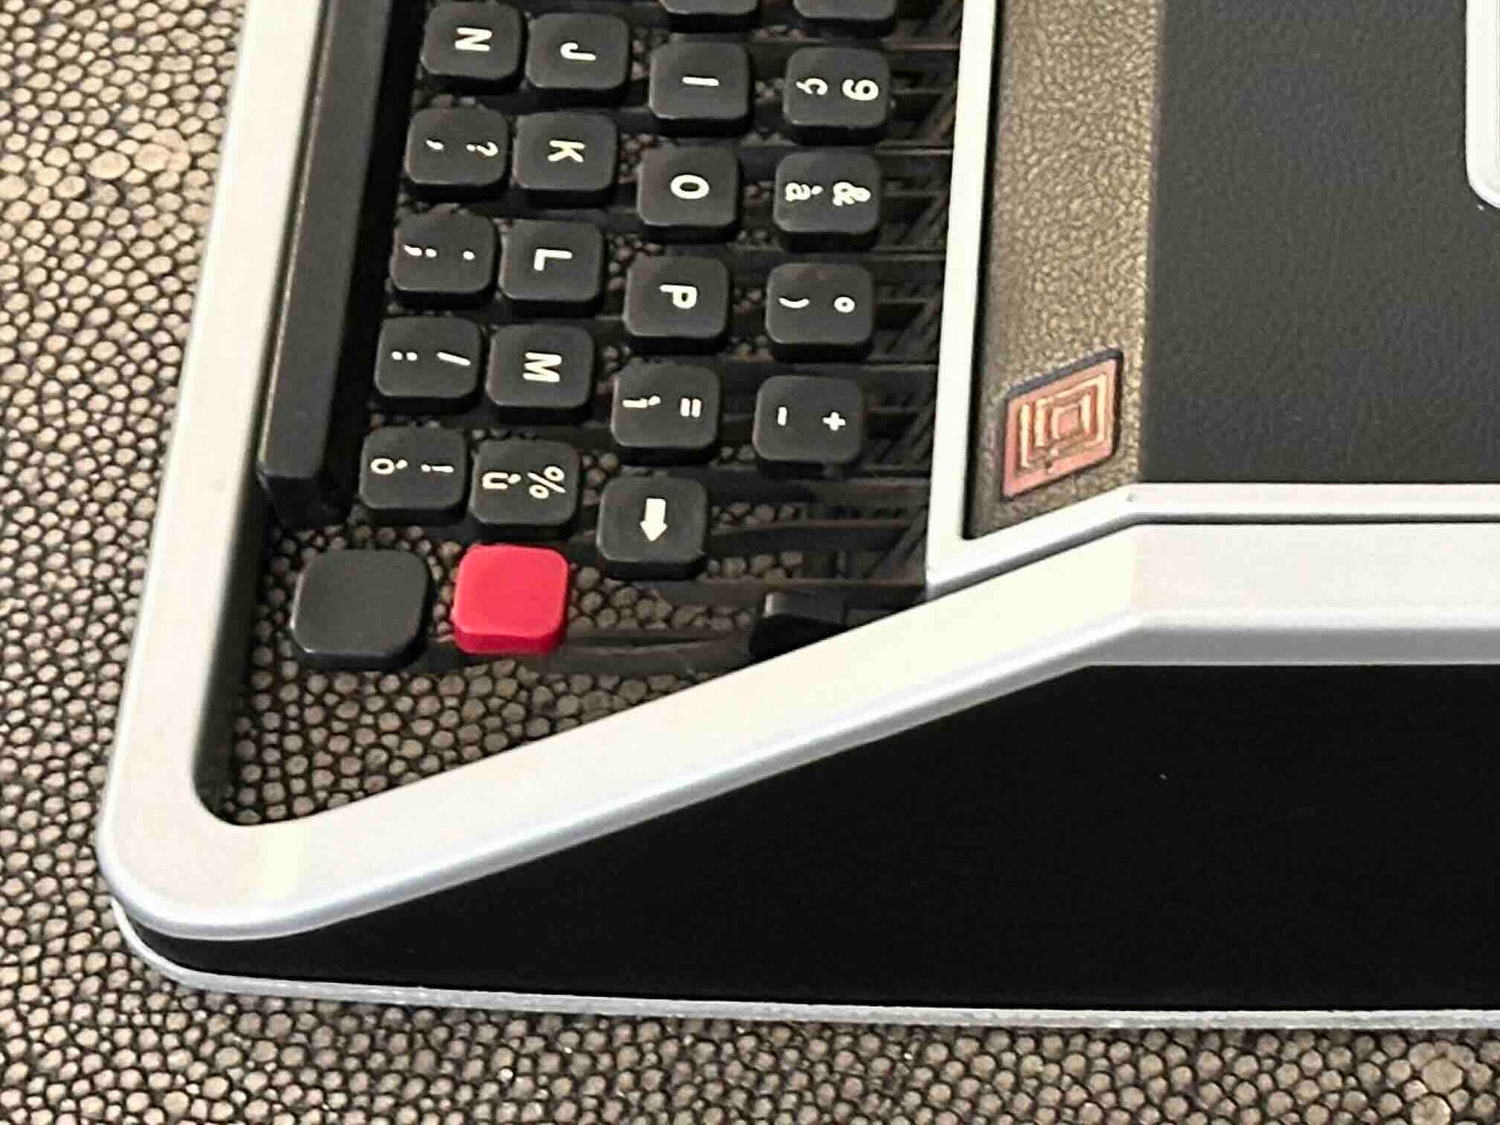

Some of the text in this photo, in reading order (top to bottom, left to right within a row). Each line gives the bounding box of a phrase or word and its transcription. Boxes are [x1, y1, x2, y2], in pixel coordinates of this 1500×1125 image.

[454, 27, 493, 52] N
[560, 42, 597, 62] J
[795, 77, 828, 96] ç
[842, 79, 879, 101] 9
[547, 140, 586, 163] K
[670, 174, 710, 200] O
[784, 182, 824, 202] à
[533, 248, 573, 272] L
[659, 284, 698, 310] P
[522, 352, 562, 383] M
[370, 458, 408, 475] ò
[482, 471, 522, 490] ù
